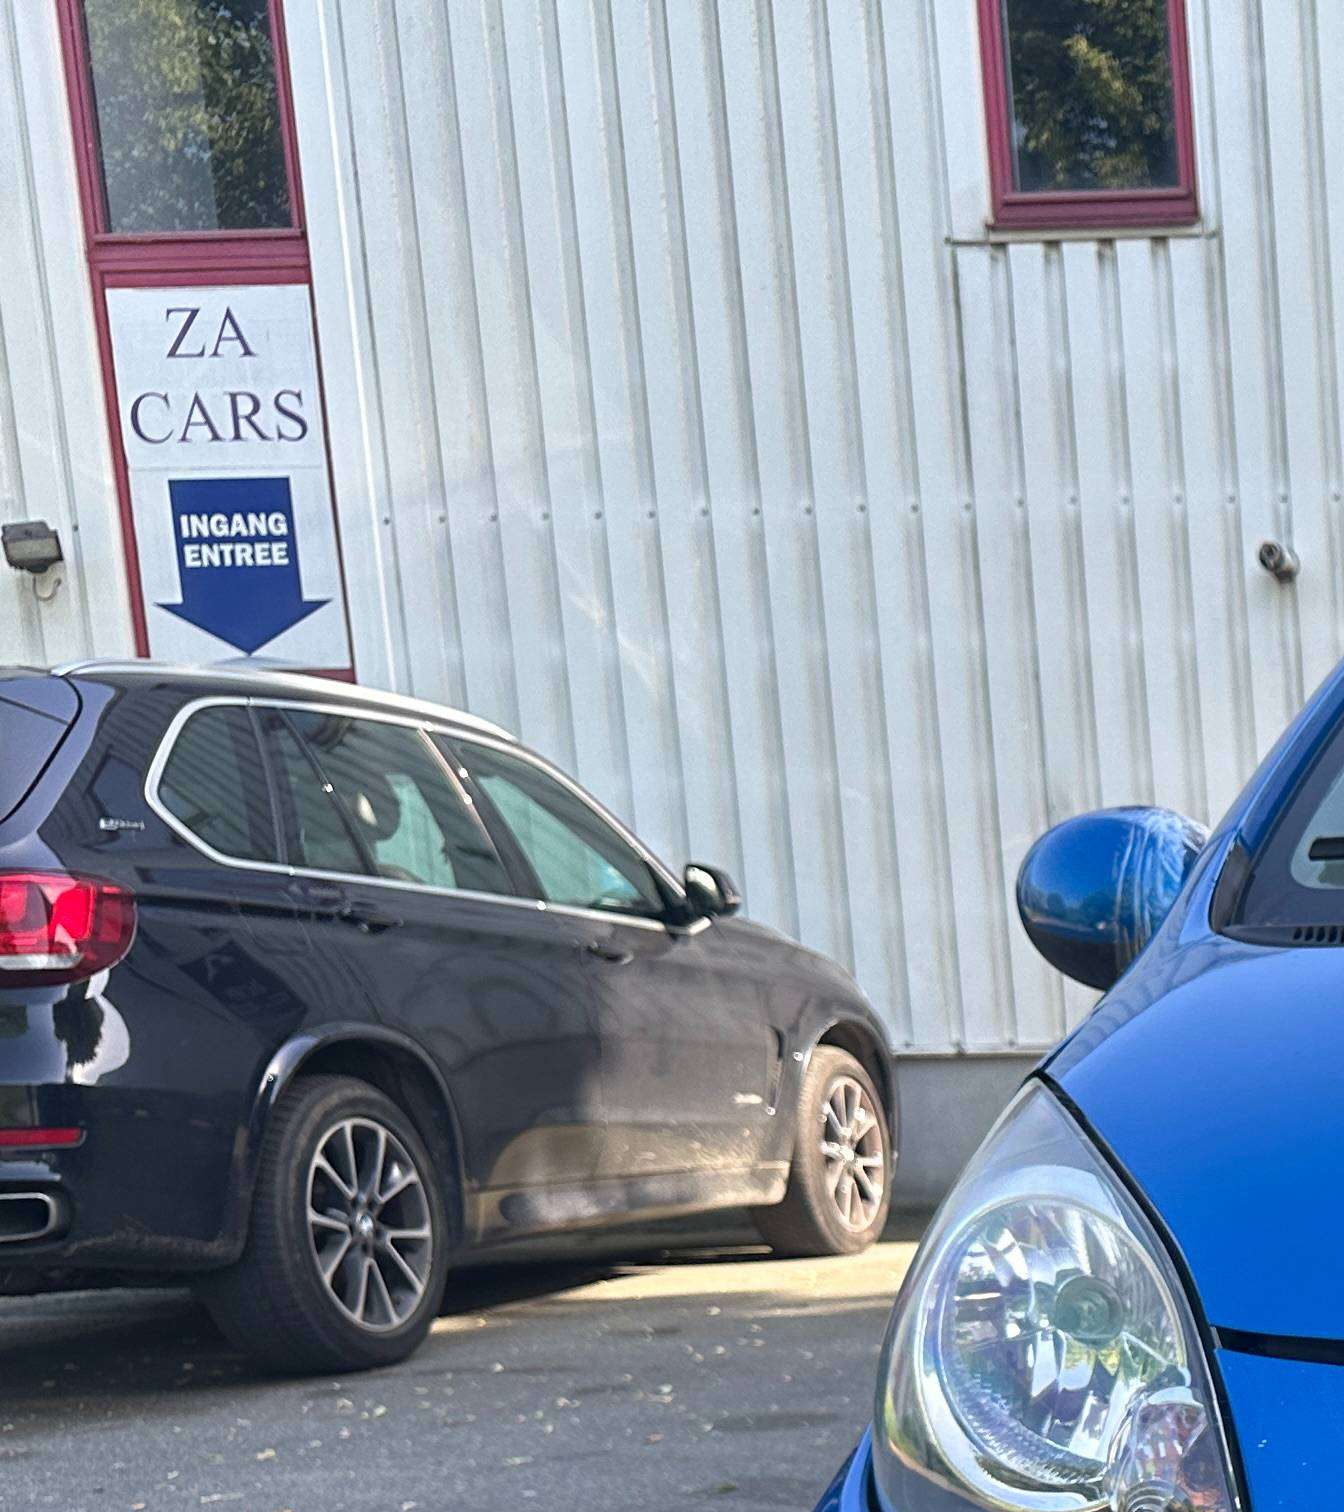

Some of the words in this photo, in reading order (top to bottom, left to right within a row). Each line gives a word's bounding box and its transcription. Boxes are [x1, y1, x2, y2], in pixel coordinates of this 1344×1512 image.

[166, 306, 257, 359] ZA
[129, 389, 309, 444] CARS
[179, 512, 289, 539] INGANG
[183, 542, 290, 568] ENTREE
